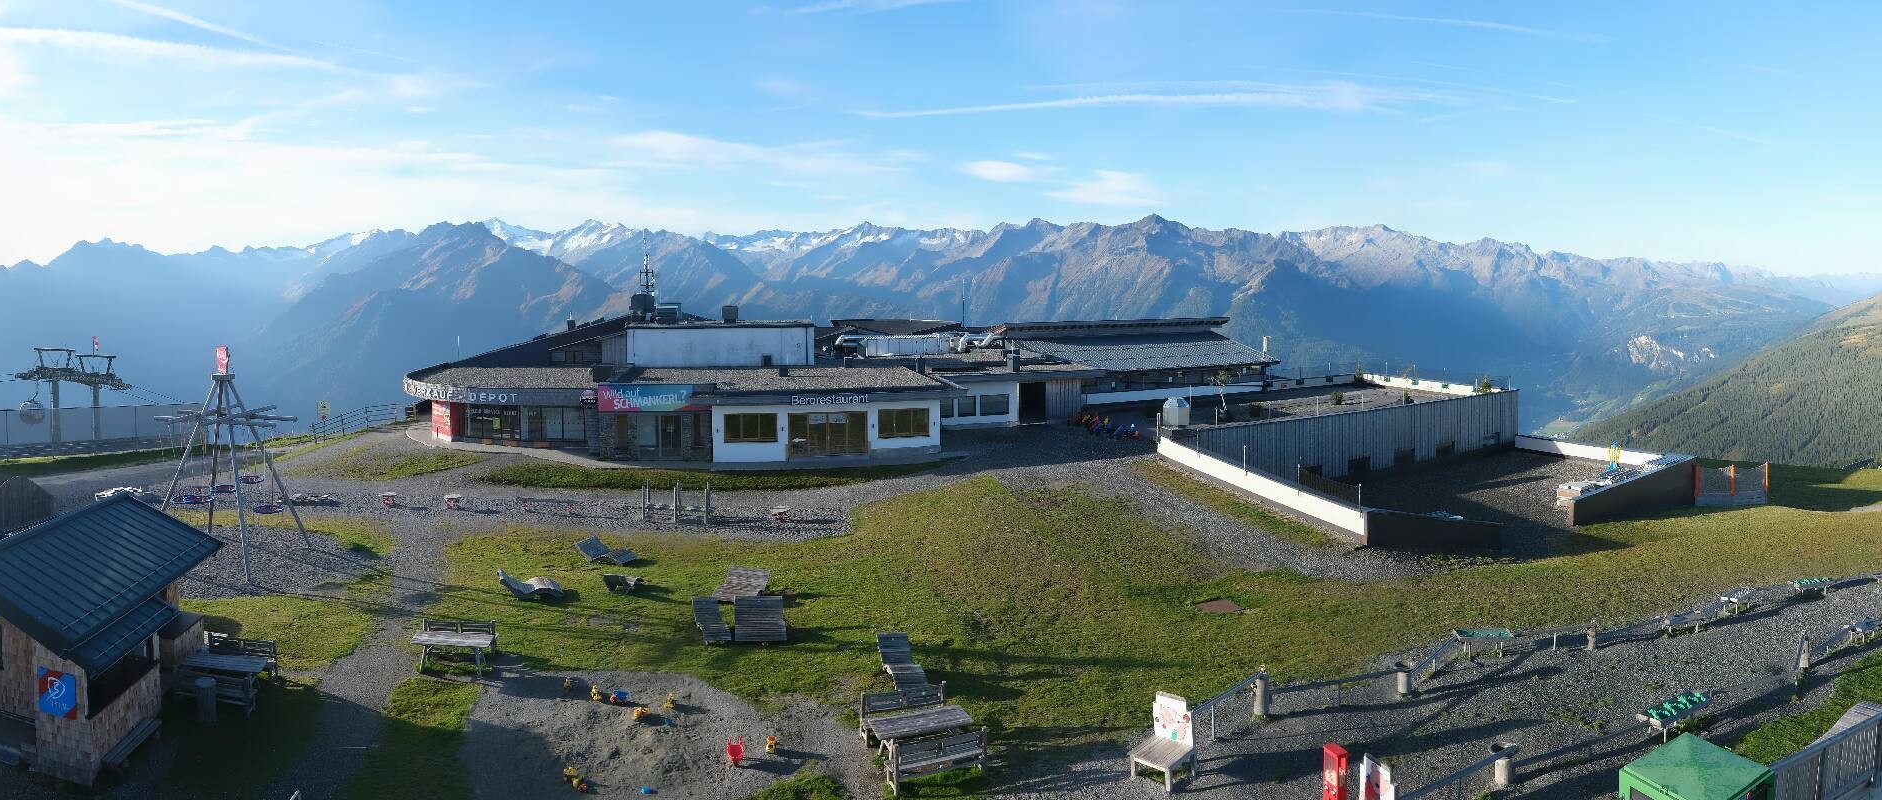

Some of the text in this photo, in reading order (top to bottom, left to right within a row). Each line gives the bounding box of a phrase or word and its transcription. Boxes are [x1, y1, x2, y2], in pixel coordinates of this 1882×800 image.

[469, 392, 518, 403] DEPOT
[602, 388, 623, 400] Wild
[625, 386, 640, 398] auf
[613, 390, 687, 410] SCHMANKERL?
[791, 394, 869, 406] Bergrestaurant
